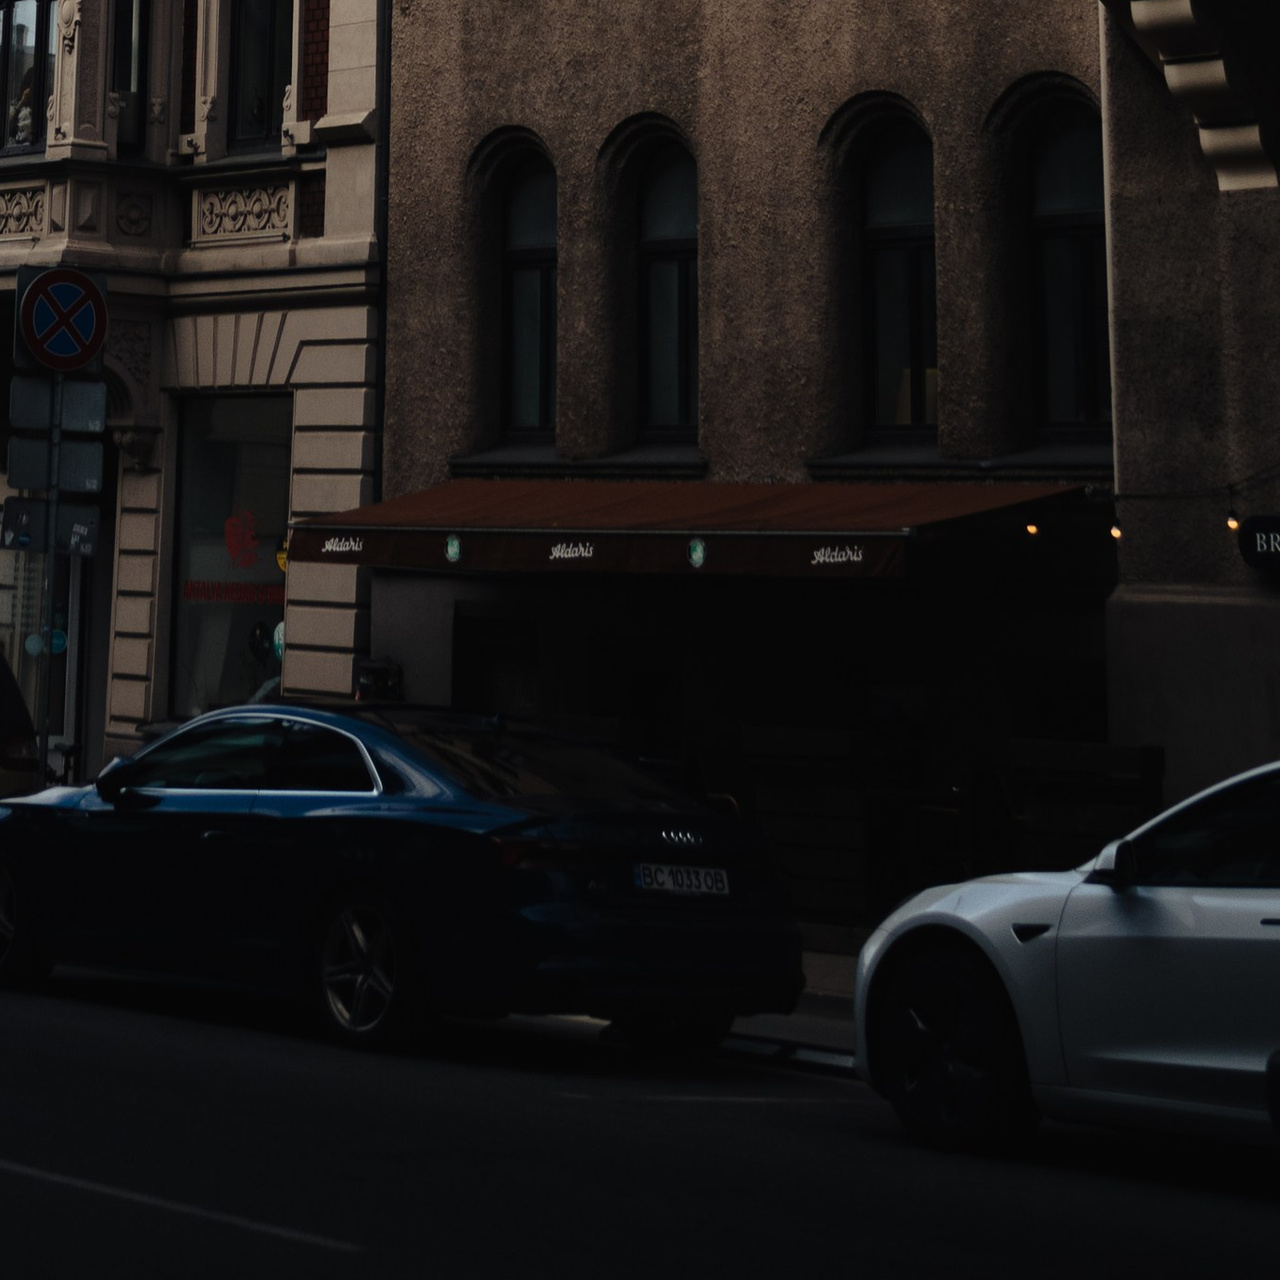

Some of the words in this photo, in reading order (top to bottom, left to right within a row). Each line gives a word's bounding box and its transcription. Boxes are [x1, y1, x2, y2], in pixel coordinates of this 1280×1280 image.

[321, 537, 363, 553] Aldaris
[549, 542, 594, 560] Aldaris
[1256, 532, 1280, 552] BR
[811, 545, 863, 565] Aldaris
[642, 866, 665, 887] BC
[669, 869, 701, 890] 1033
[704, 871, 725, 892] OB
